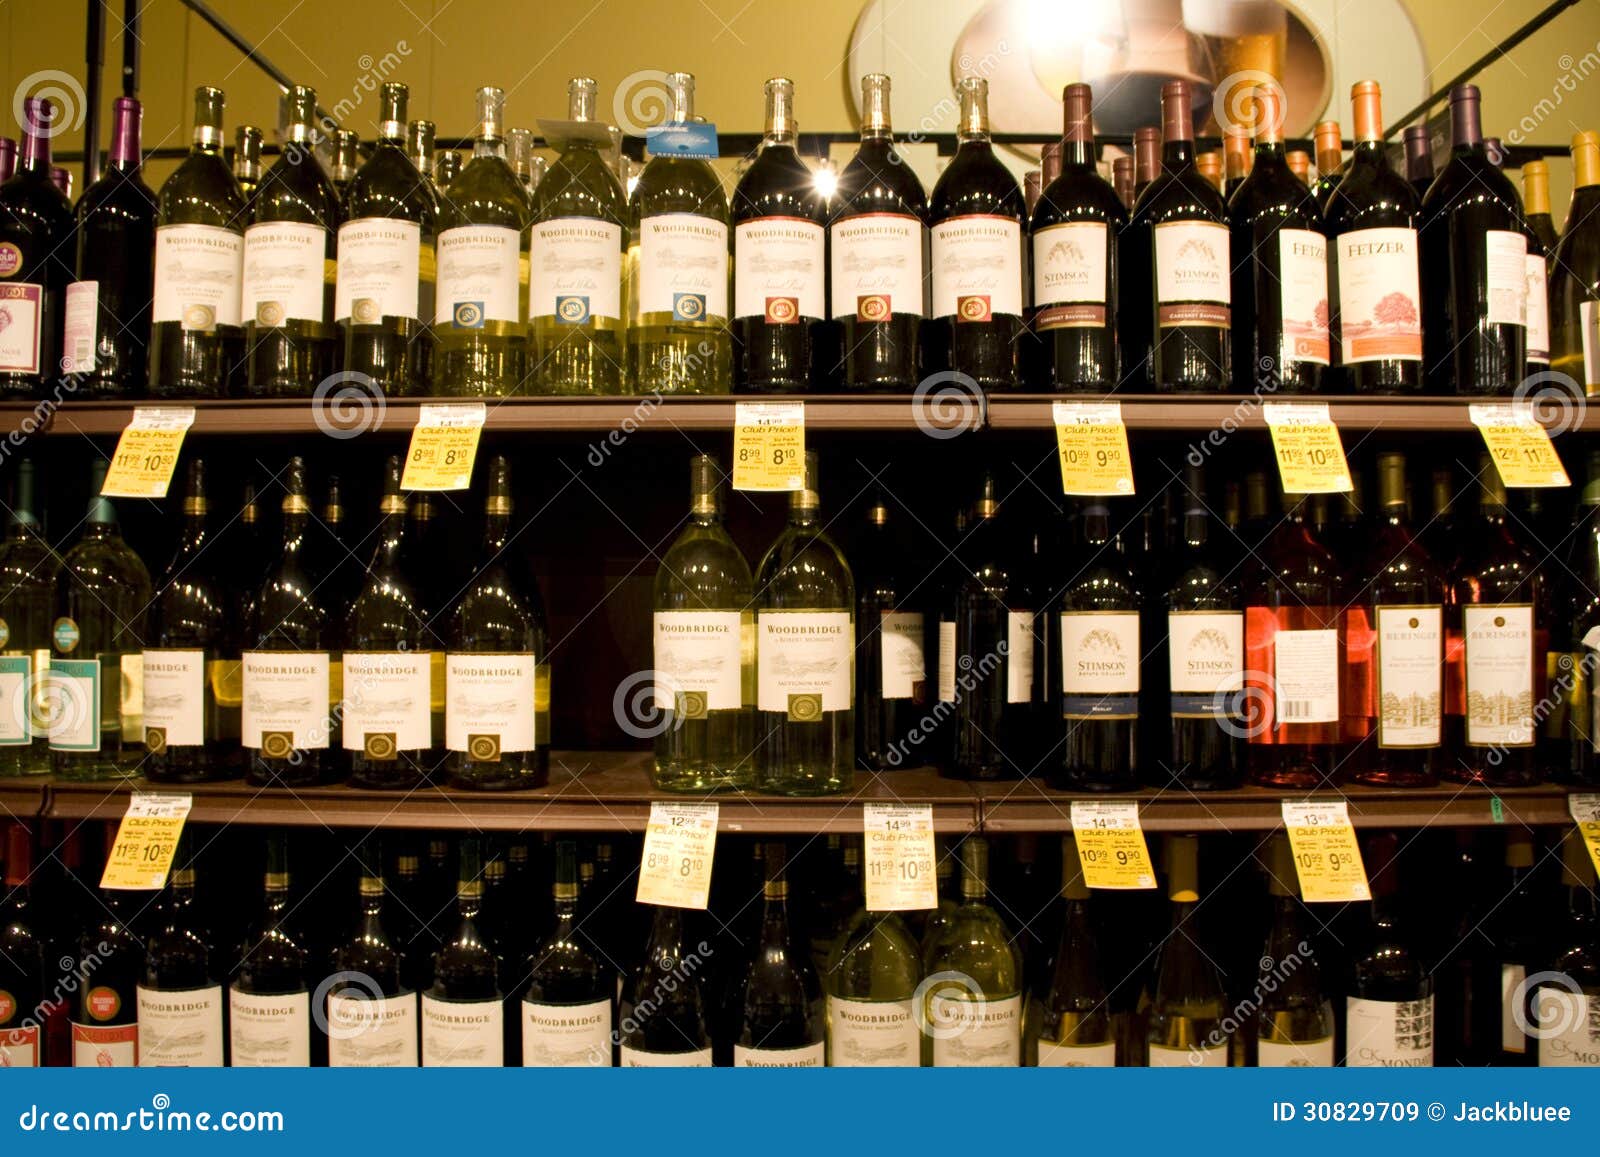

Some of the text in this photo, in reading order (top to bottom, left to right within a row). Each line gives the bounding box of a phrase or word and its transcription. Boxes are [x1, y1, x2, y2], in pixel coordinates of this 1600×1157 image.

[540, 228, 611, 241] WOODBRIDGE
[653, 224, 722, 239] WOODBRIDGE
[746, 230, 816, 241] WOODBRIDGE
[839, 227, 910, 239] WOODBRIDGE
[940, 227, 1010, 241] WOODBRIDGE
[1348, 242, 1405, 257] FETZER
[1044, 271, 1089, 282] STIMSON
[1174, 270, 1220, 279] STIMSON
[1065, 426, 1088, 434] Club
[659, 623, 730, 633] WOODBRIDGE
[767, 624, 842, 634] WOODBRIDGE
[1386, 632, 1437, 641] BERINGER
[1472, 631, 1527, 640] BERINGER
[248, 665, 318, 675] WOODBRIDGE
[1078, 660, 1126, 671] STIMSON
[1187, 660, 1233, 670] STIMSON
[452, 666, 523, 676] WOODBRIDGE
[872, 833, 896, 841] Club
[1296, 828, 1317, 836] Club
[141, 998, 210, 1012] WOODBRIDGE
[425, 1008, 490, 1023] WOODBRIDGE
[530, 1014, 603, 1027] WOODBRIDGE
[840, 1010, 912, 1024] WOODBRIDGE
